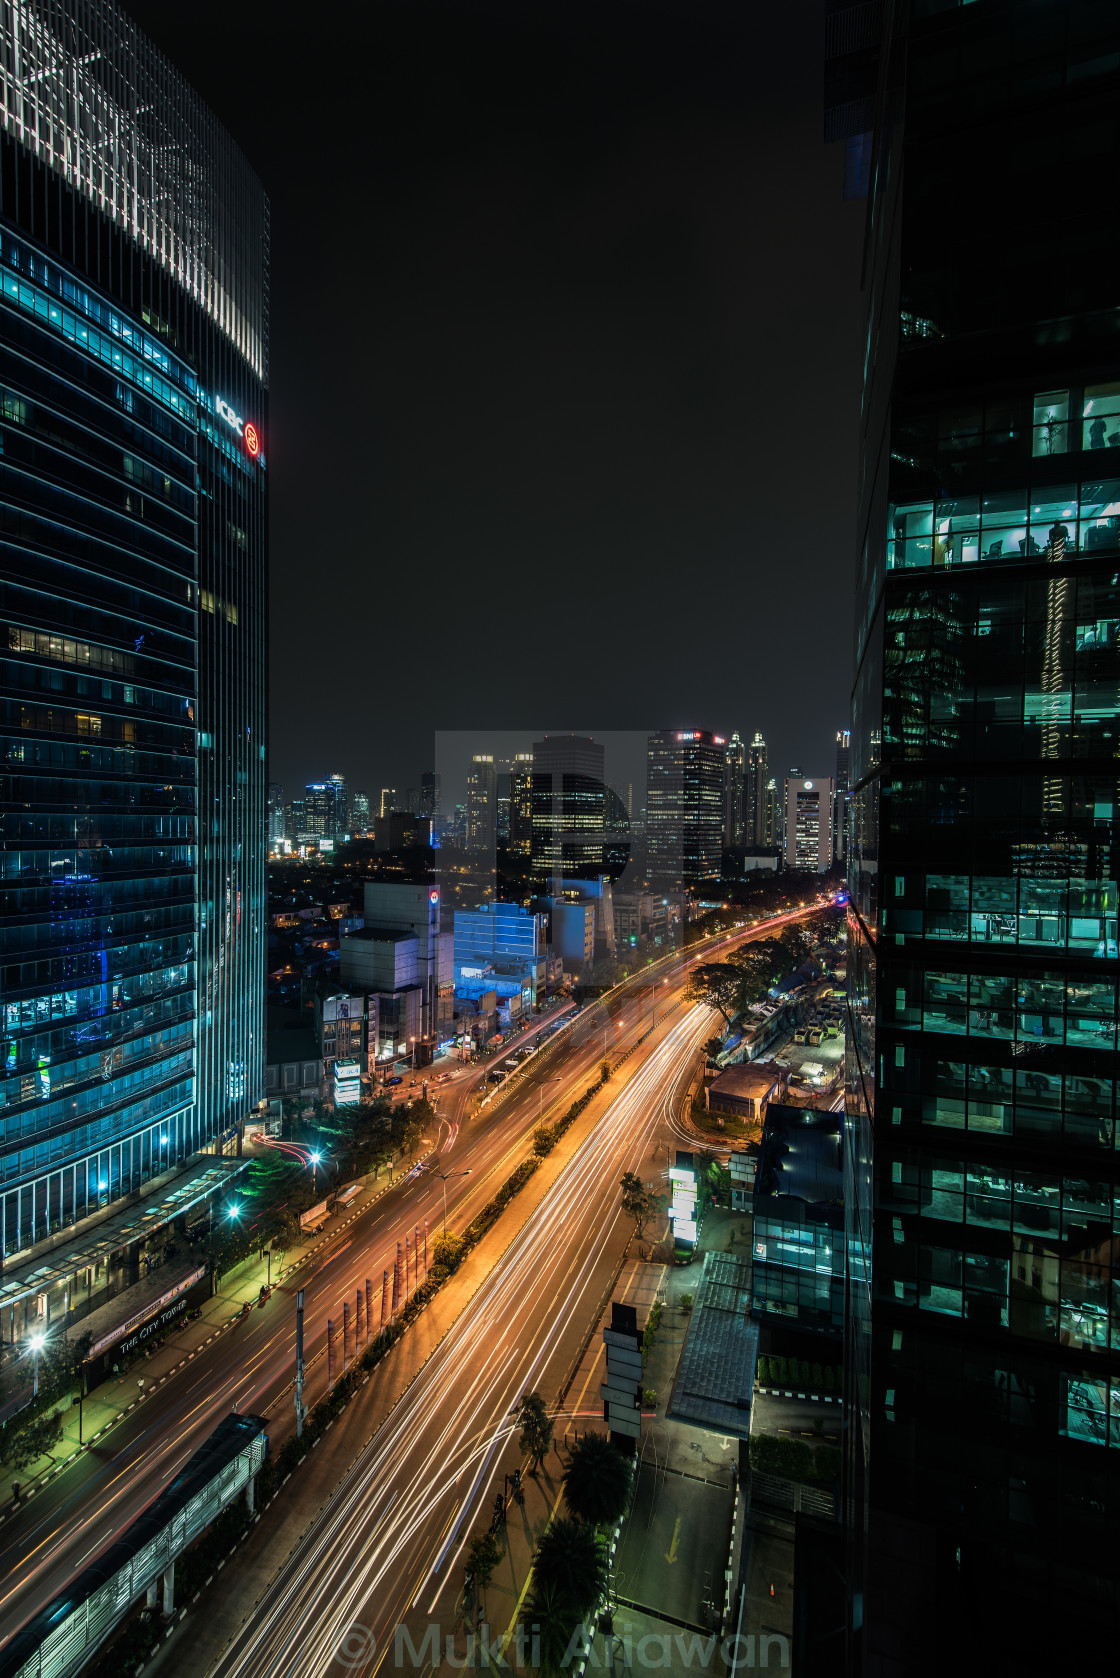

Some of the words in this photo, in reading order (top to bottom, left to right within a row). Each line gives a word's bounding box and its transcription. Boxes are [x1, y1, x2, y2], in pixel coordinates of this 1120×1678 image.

[216, 395, 243, 437] ICBC
[120, 1336, 138, 1354] THE
[139, 1319, 159, 1339] CITY
[160, 1299, 187, 1324] TOWER
